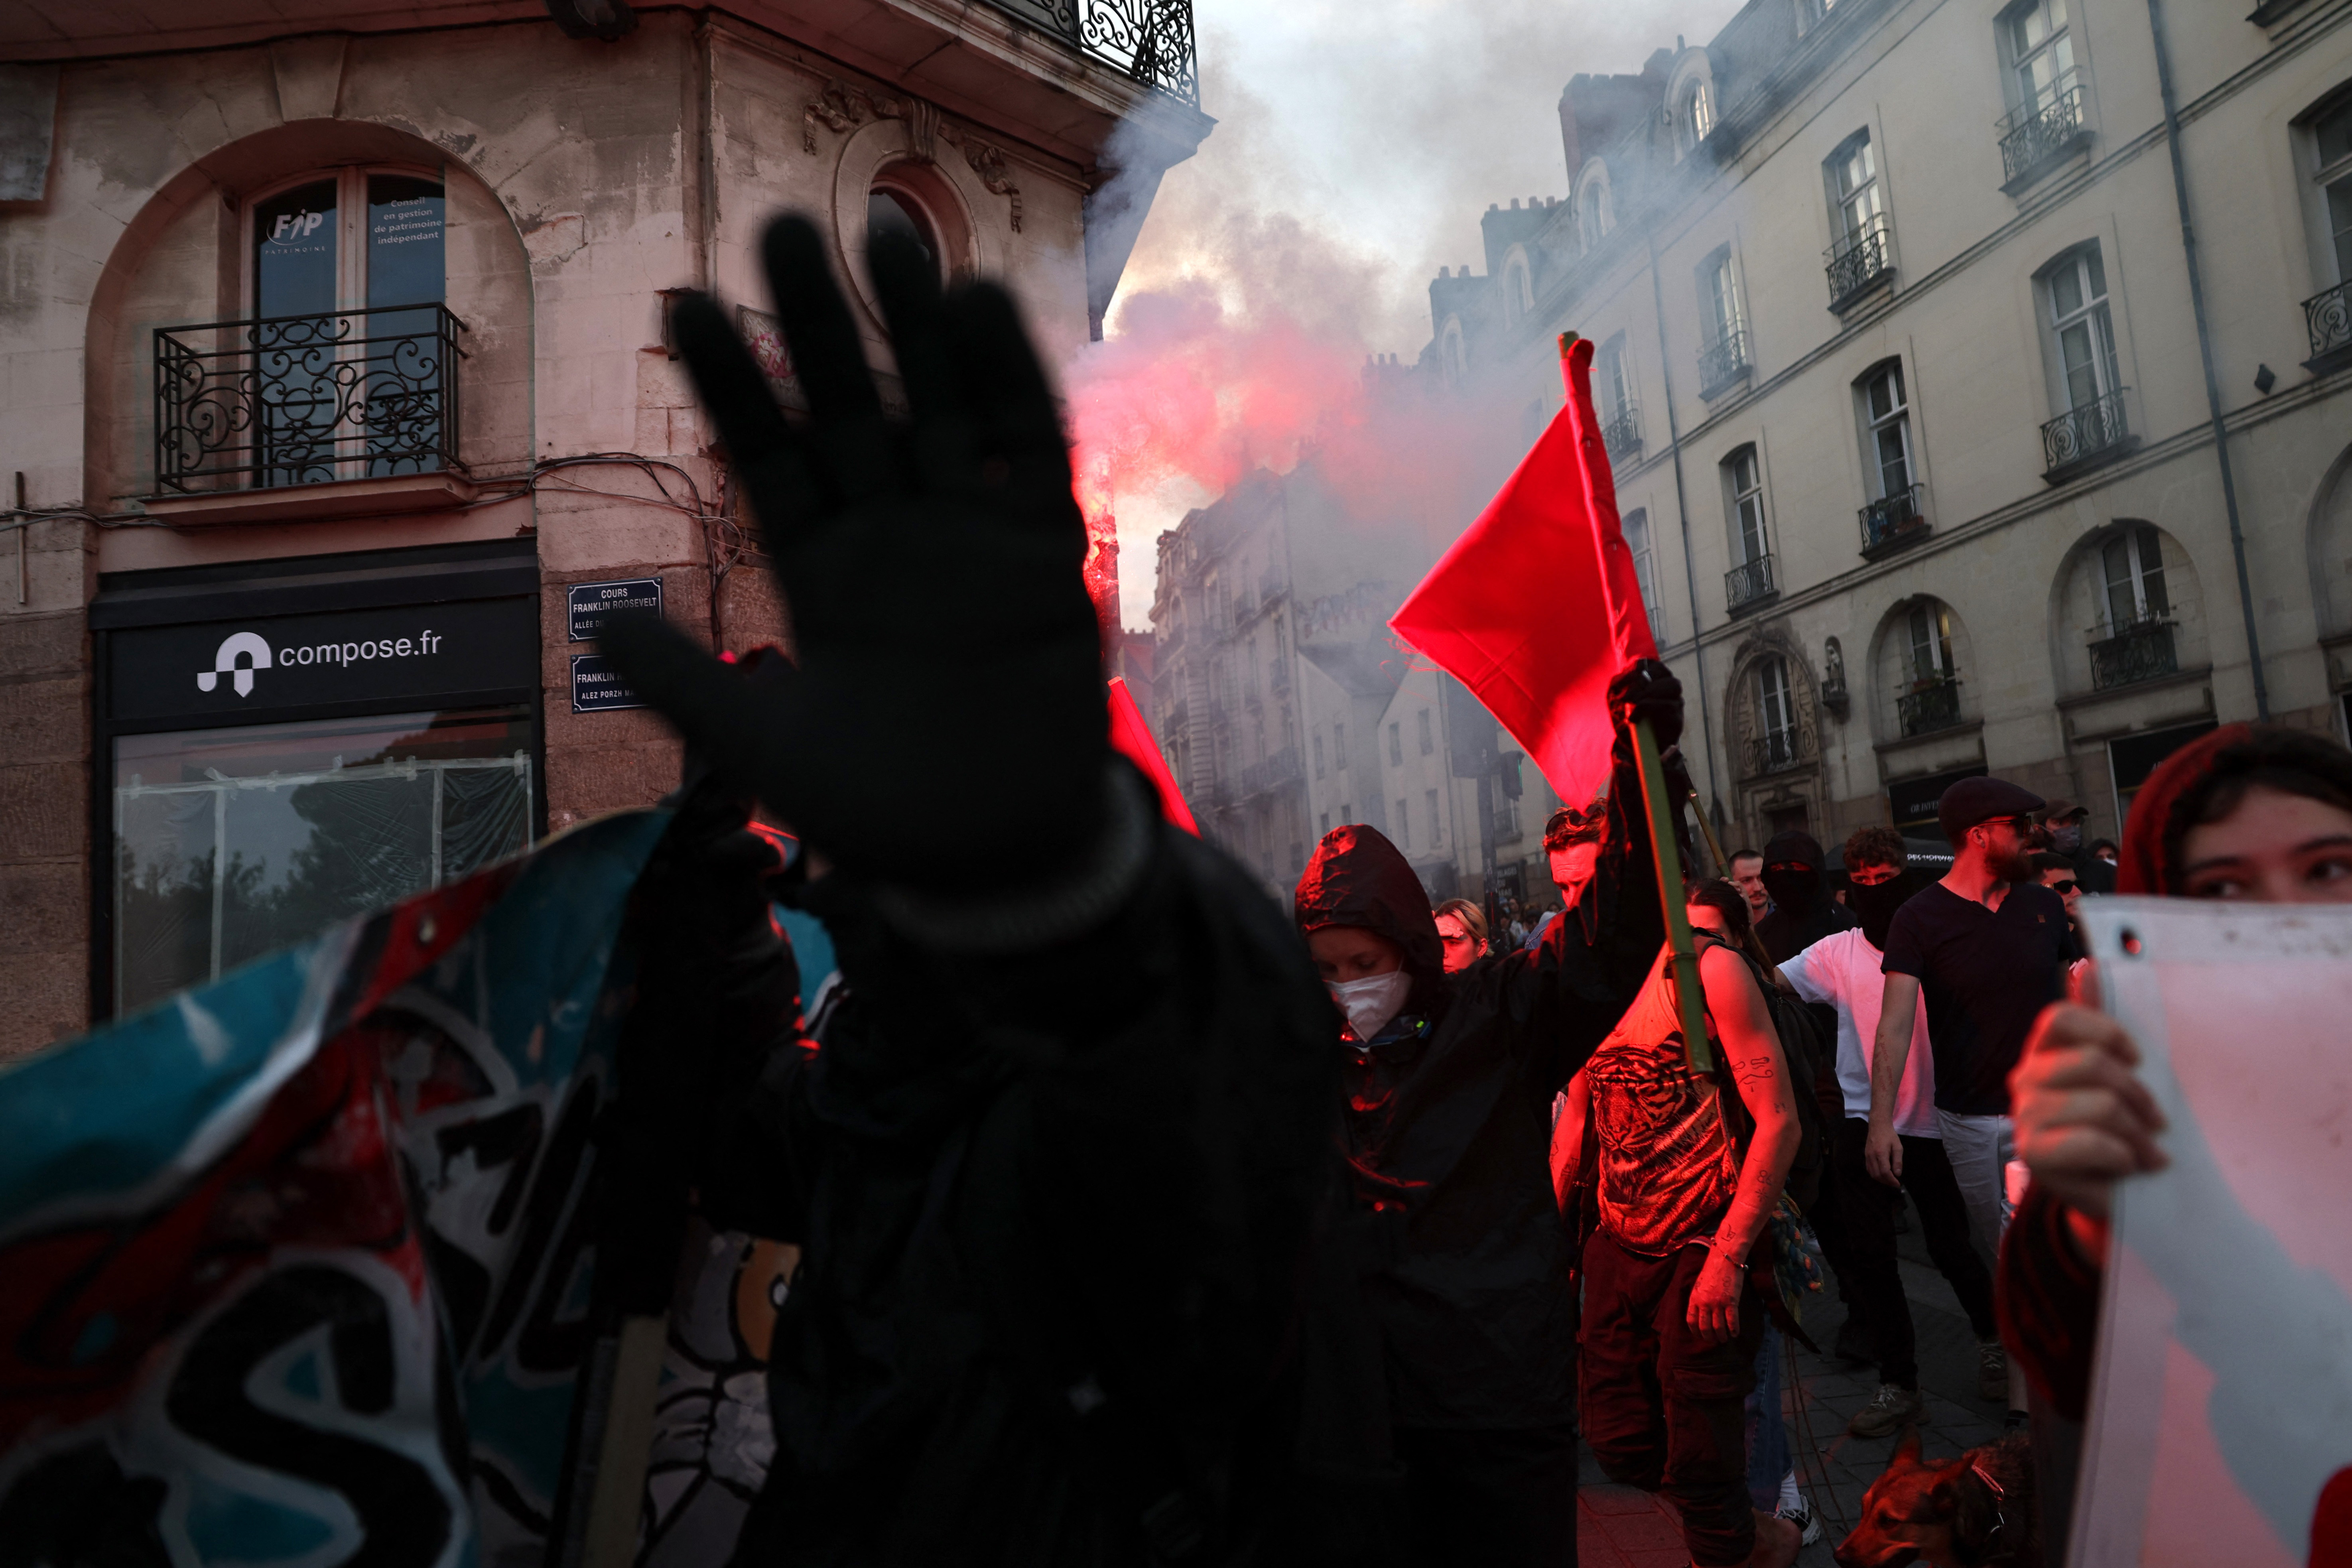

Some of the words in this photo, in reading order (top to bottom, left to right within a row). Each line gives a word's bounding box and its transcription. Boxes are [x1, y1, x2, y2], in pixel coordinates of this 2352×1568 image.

[391, 197, 425, 207] Conseil
[398, 208, 433, 220] gestion
[374, 225, 386, 233] de
[389, 219, 442, 234] patrimoine
[378, 231, 439, 245] indépendant
[265, 246, 326, 254] PATRIMOINE
[601, 588, 628, 599] COURS
[573, 601, 610, 613] FRANKLIN
[613, 597, 656, 609] ROOSEVELT
[574, 620, 593, 629] ALLÉE
[279, 630, 442, 667] compose.fr
[577, 672, 614, 683] FRANKLIN
